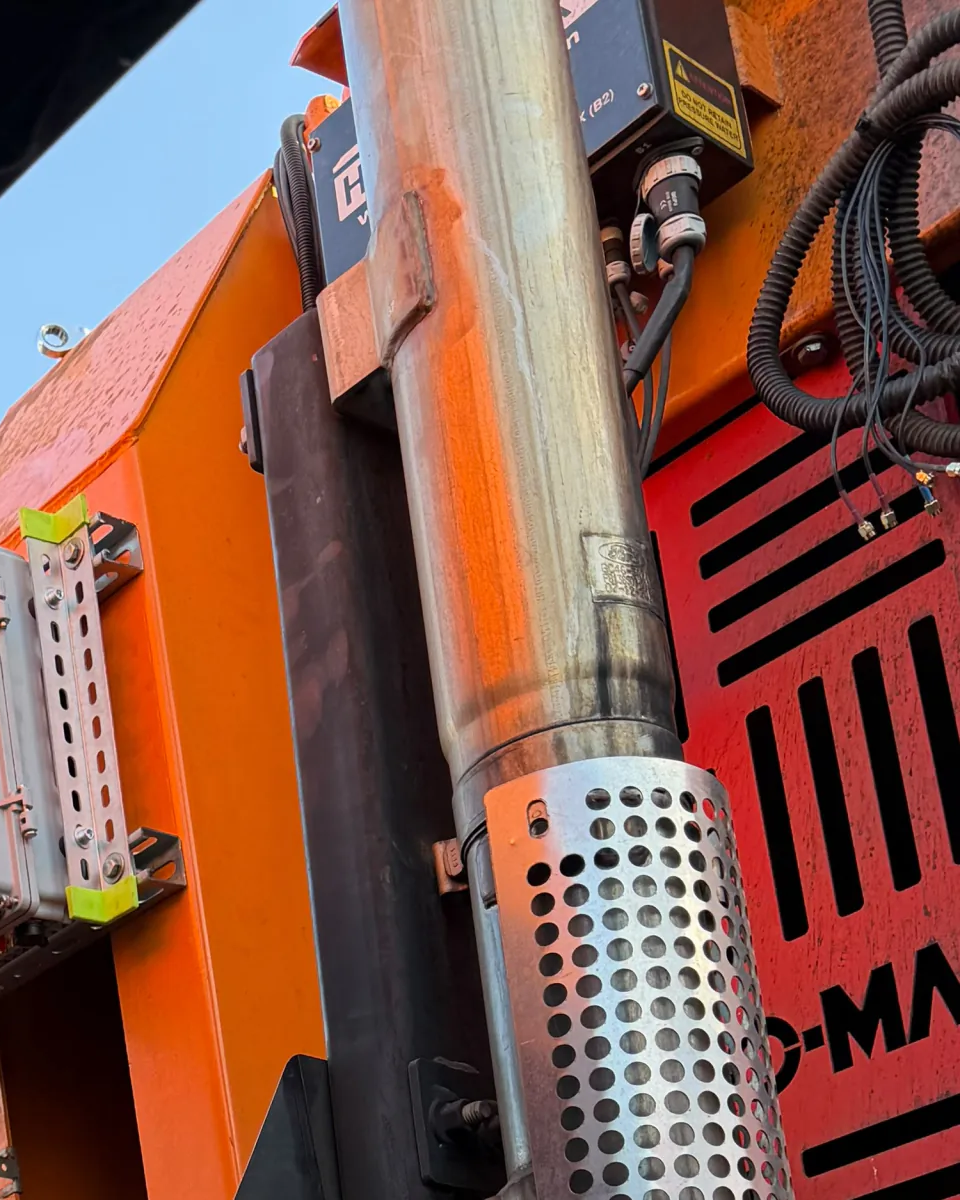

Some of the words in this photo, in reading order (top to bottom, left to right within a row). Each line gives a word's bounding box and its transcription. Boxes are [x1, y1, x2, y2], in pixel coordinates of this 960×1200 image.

[589, 88, 614, 118] (B2)
[681, 90, 692, 101] DO
[693, 97, 707, 112] NOT
[678, 98, 714, 125] PRESSURE
[716, 122, 739, 140] WATER
